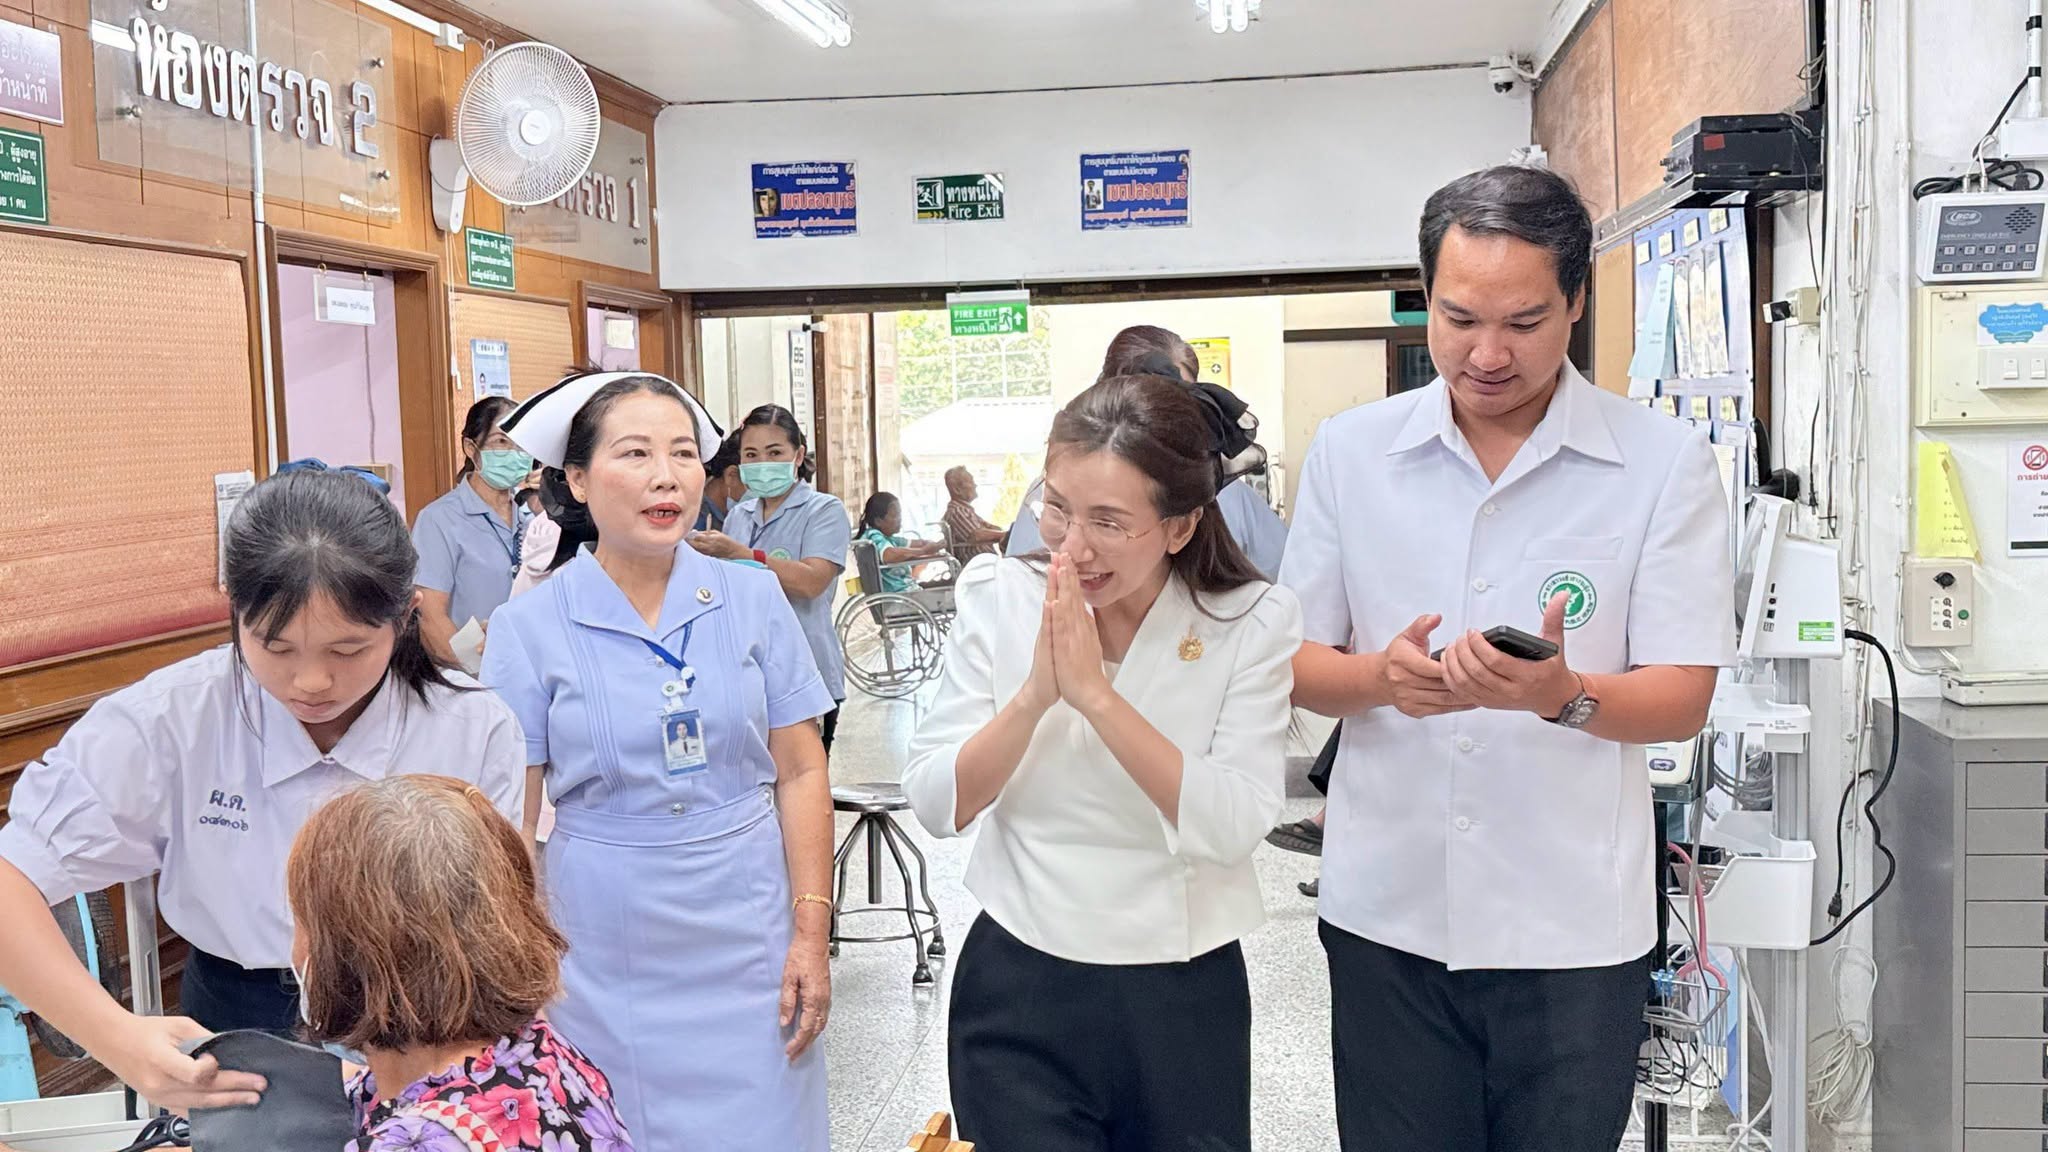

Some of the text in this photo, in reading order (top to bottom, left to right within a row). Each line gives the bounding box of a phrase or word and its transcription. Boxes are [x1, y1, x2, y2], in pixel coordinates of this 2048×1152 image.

[351, 80, 380, 159] 2
[780, 179, 855, 215] เขตปลอดบุหรี่
[946, 178, 1000, 202] ทางหนีไฟ
[1106, 169, 1187, 206] เขตปลอดบุหรี่
[9, 196, 13, 208] 1
[16, 198, 27, 209] คน
[629, 177, 641, 229] 1
[948, 203, 1001, 219] Fire Exit
[954, 309, 998, 319] FIRE EXIT
[954, 320, 998, 334] ทางหนีไฟ
